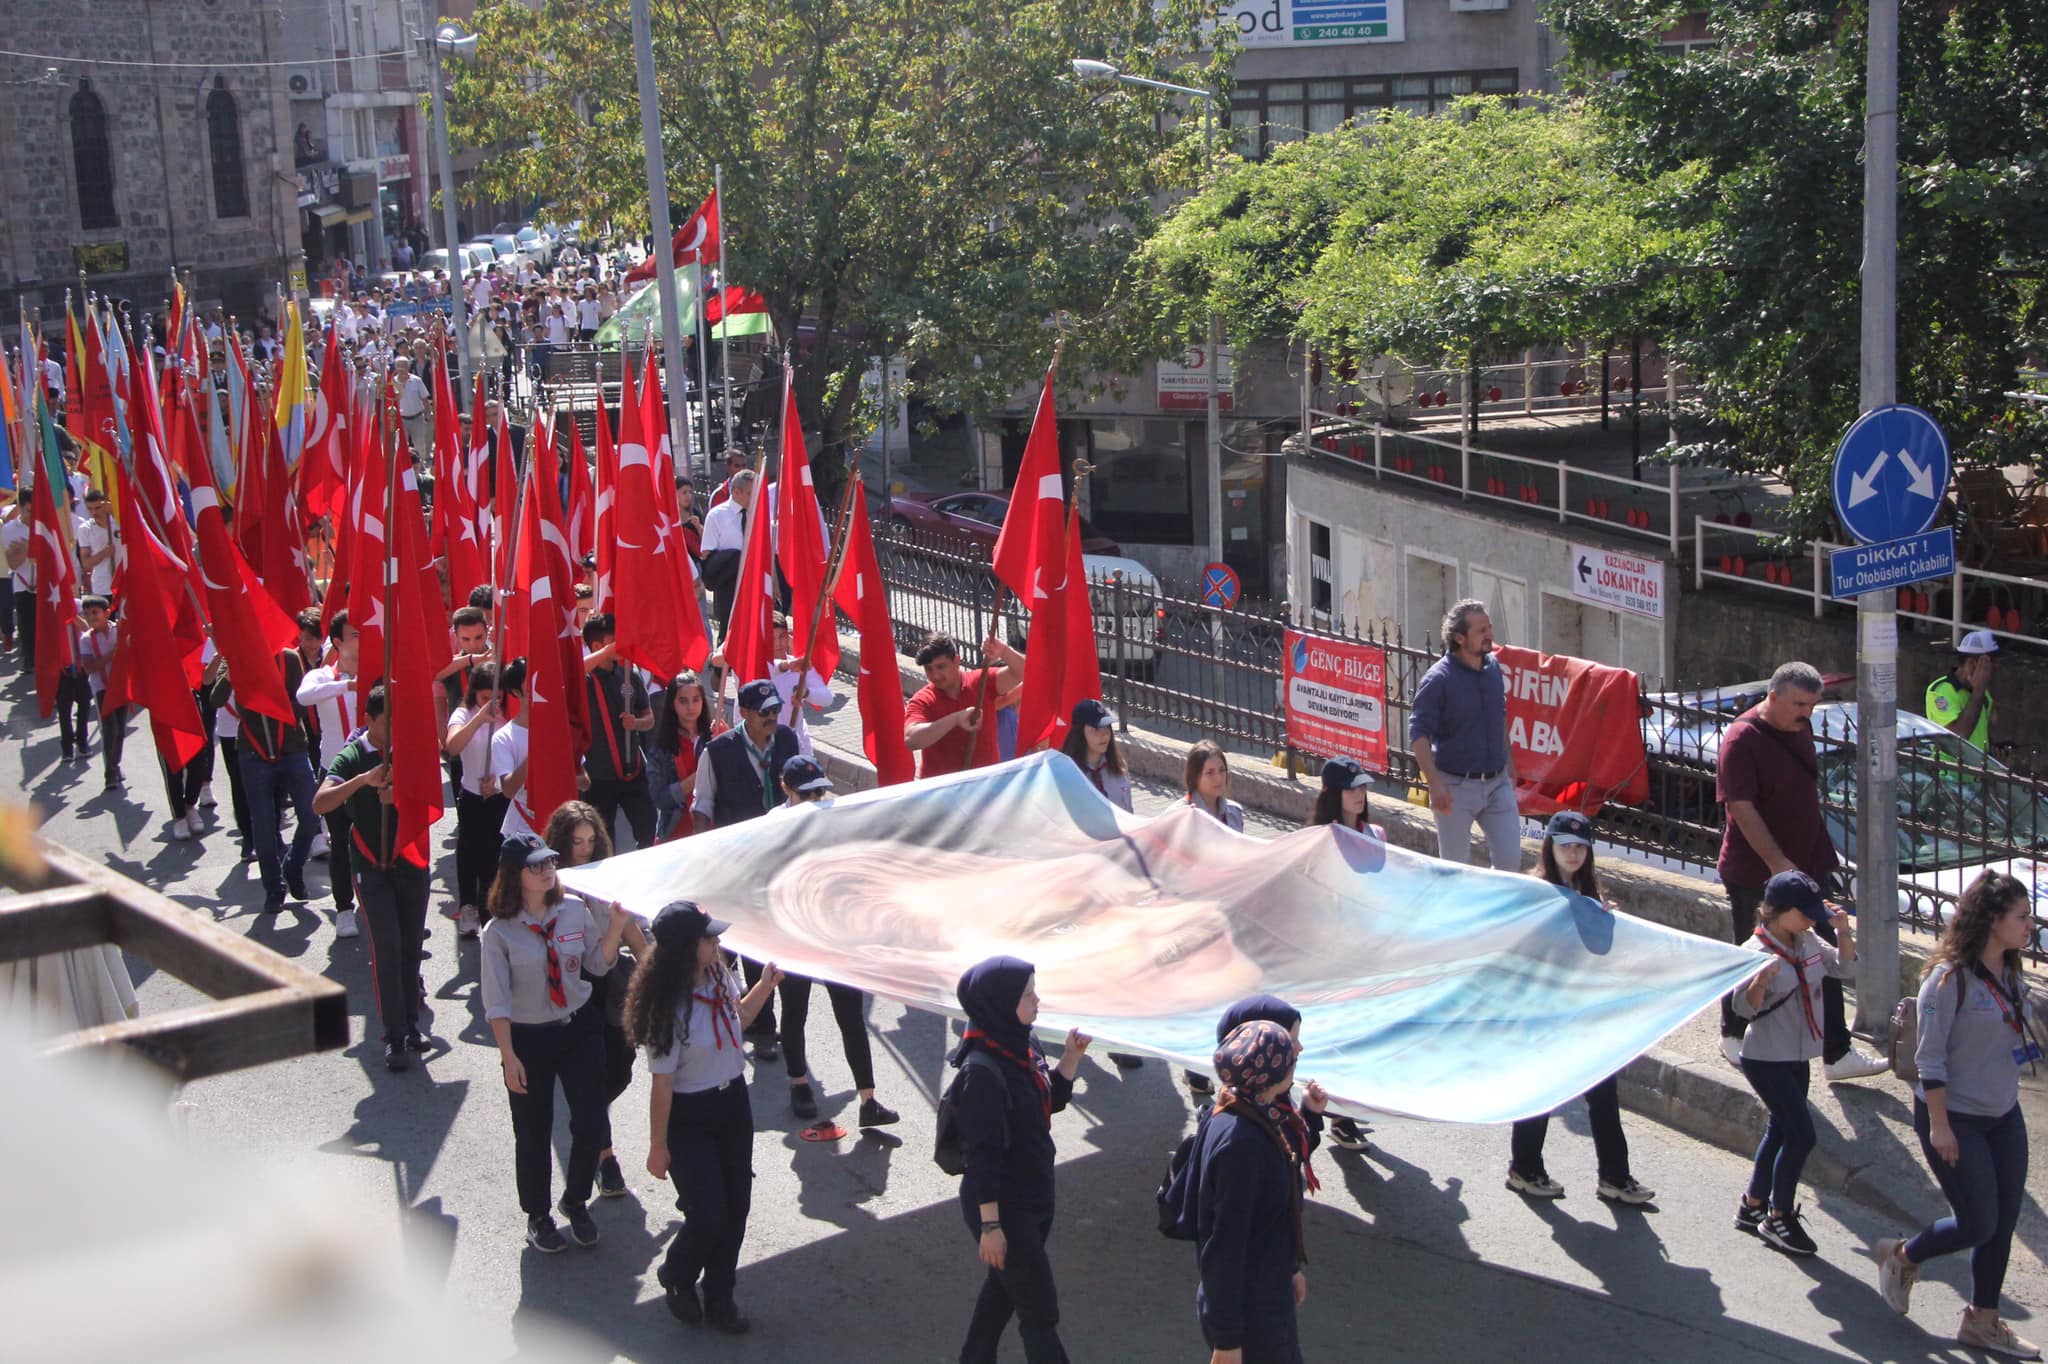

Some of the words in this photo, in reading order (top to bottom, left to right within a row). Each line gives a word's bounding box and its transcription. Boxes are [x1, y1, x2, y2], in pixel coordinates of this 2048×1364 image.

[1318, 28, 1338, 38] 240
[1341, 27, 1354, 36] 40
[1357, 26, 1371, 35] 40
[1312, 553, 1331, 584] TUVAL
[1605, 555, 1646, 575] KAZANCILAR
[1857, 542, 1917, 566] DİKKAT
[1597, 568, 1658, 598] LOKANTASI
[1836, 575, 1853, 590] Tur
[1856, 562, 1907, 586] Otobüsleri
[1910, 554, 1950, 578] Çıkabilir
[1310, 650, 1342, 678] GENÇ
[1344, 656, 1381, 683] BİLGE
[1296, 683, 1327, 700] AVANTAJLI
[1328, 692, 1373, 711] KAYITLARIMIZ
[1308, 700, 1329, 715] DEVAM
[1509, 716, 1564, 757] ABA
